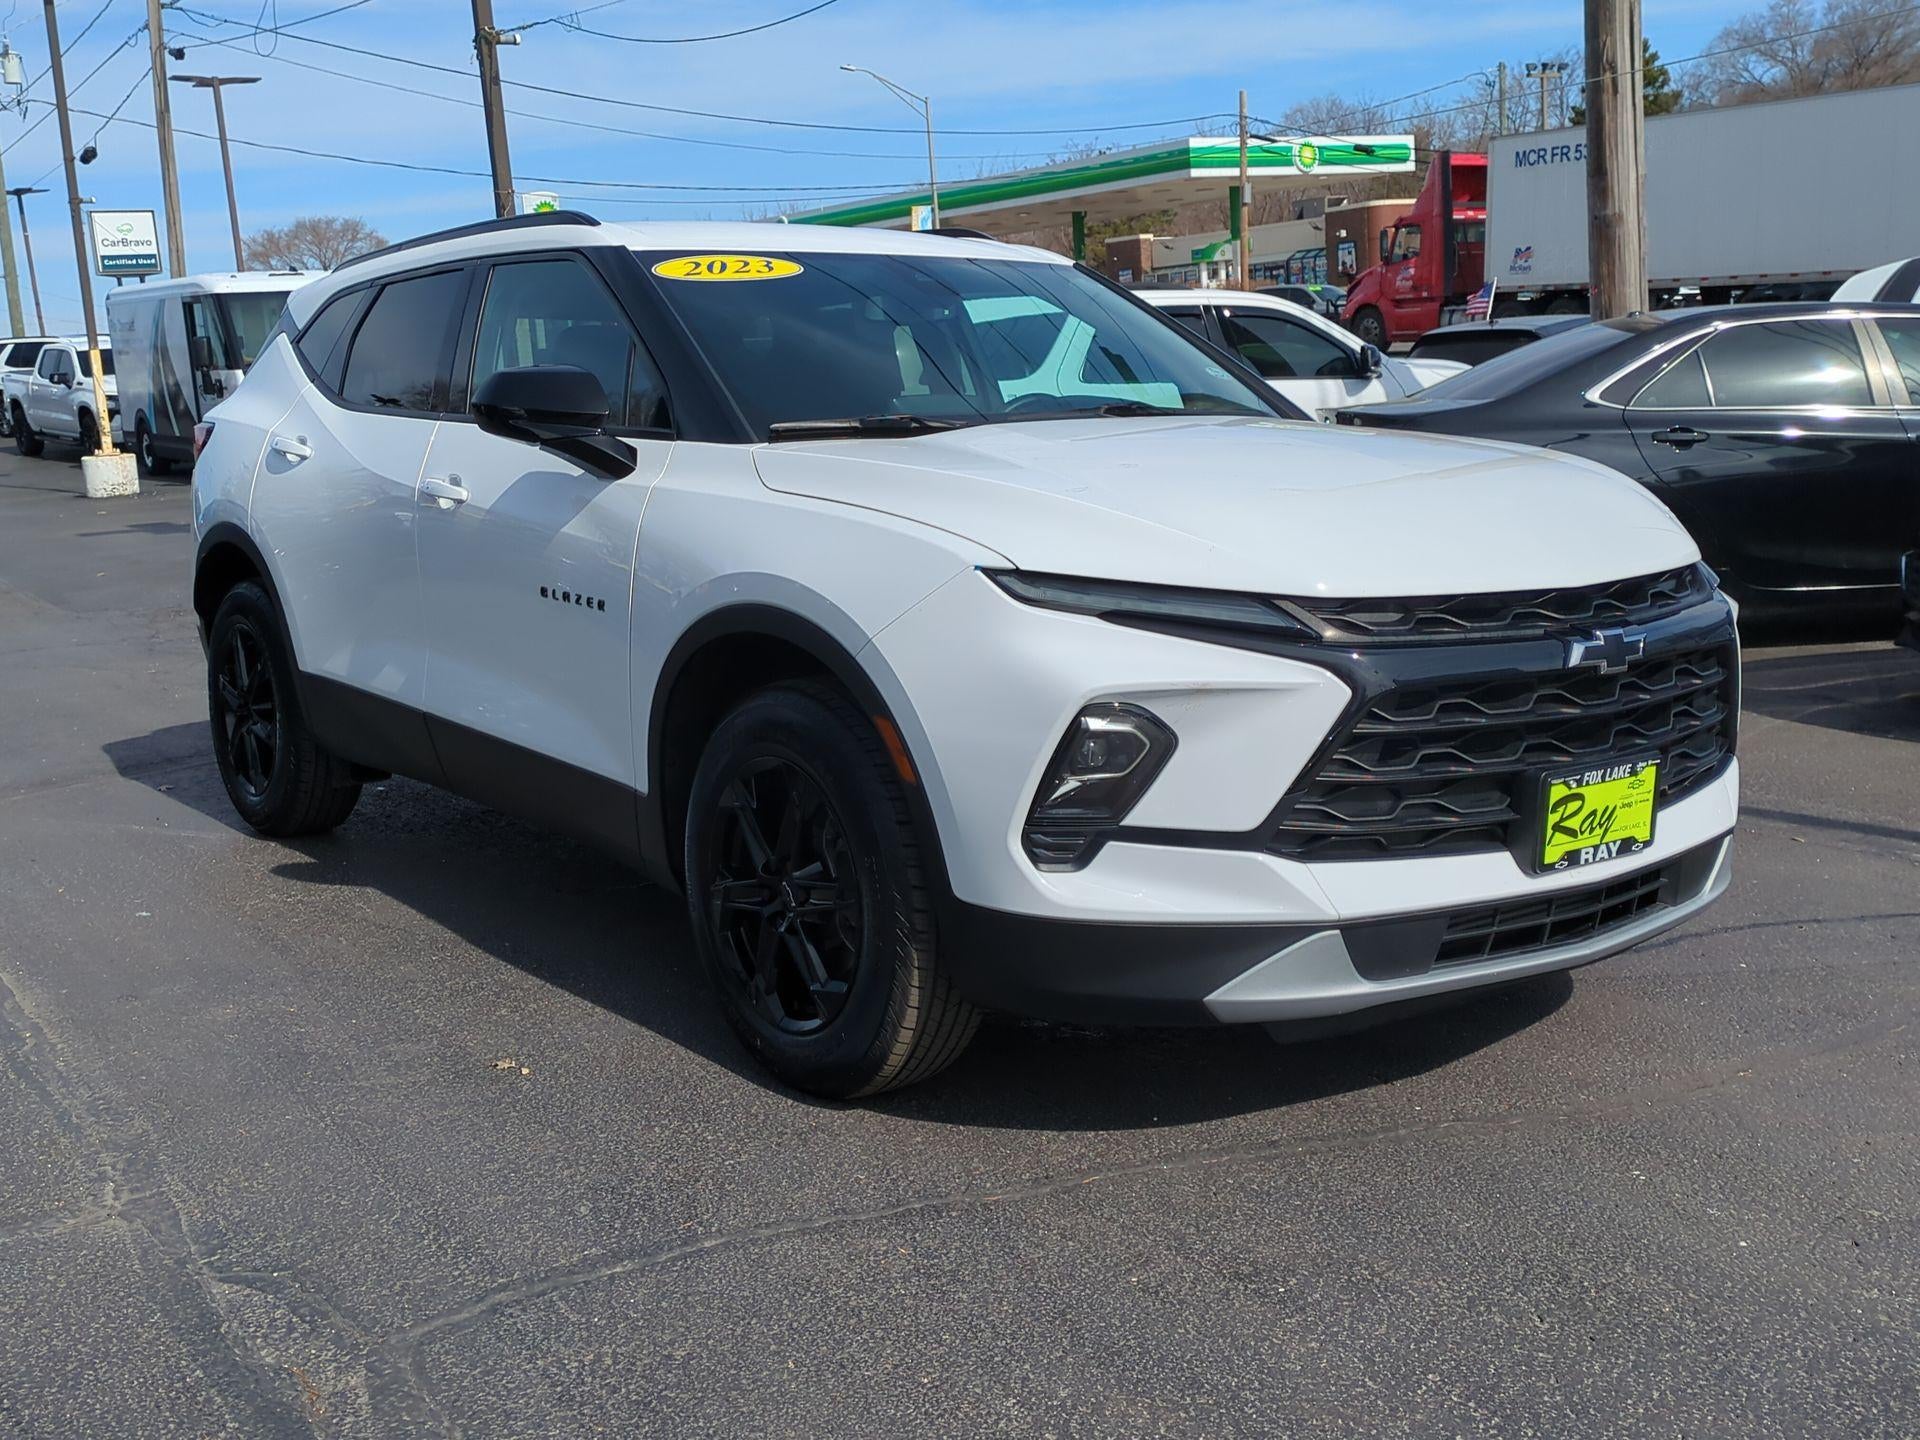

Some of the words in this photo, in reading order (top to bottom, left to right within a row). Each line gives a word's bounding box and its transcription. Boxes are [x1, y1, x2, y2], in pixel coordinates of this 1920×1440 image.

[1515, 148, 1547, 168] MCR
[1551, 145, 1571, 163] FR
[101, 237, 152, 247] CarBravo
[104, 258, 137, 266] Certified
[683, 259, 774, 277] 2023
[540, 586, 606, 612] BLAZER
[1582, 769, 1605, 786] FOX
[1605, 763, 1633, 781] LAKE
[1546, 792, 1618, 847] Ray
[1580, 840, 1622, 864] RAY
